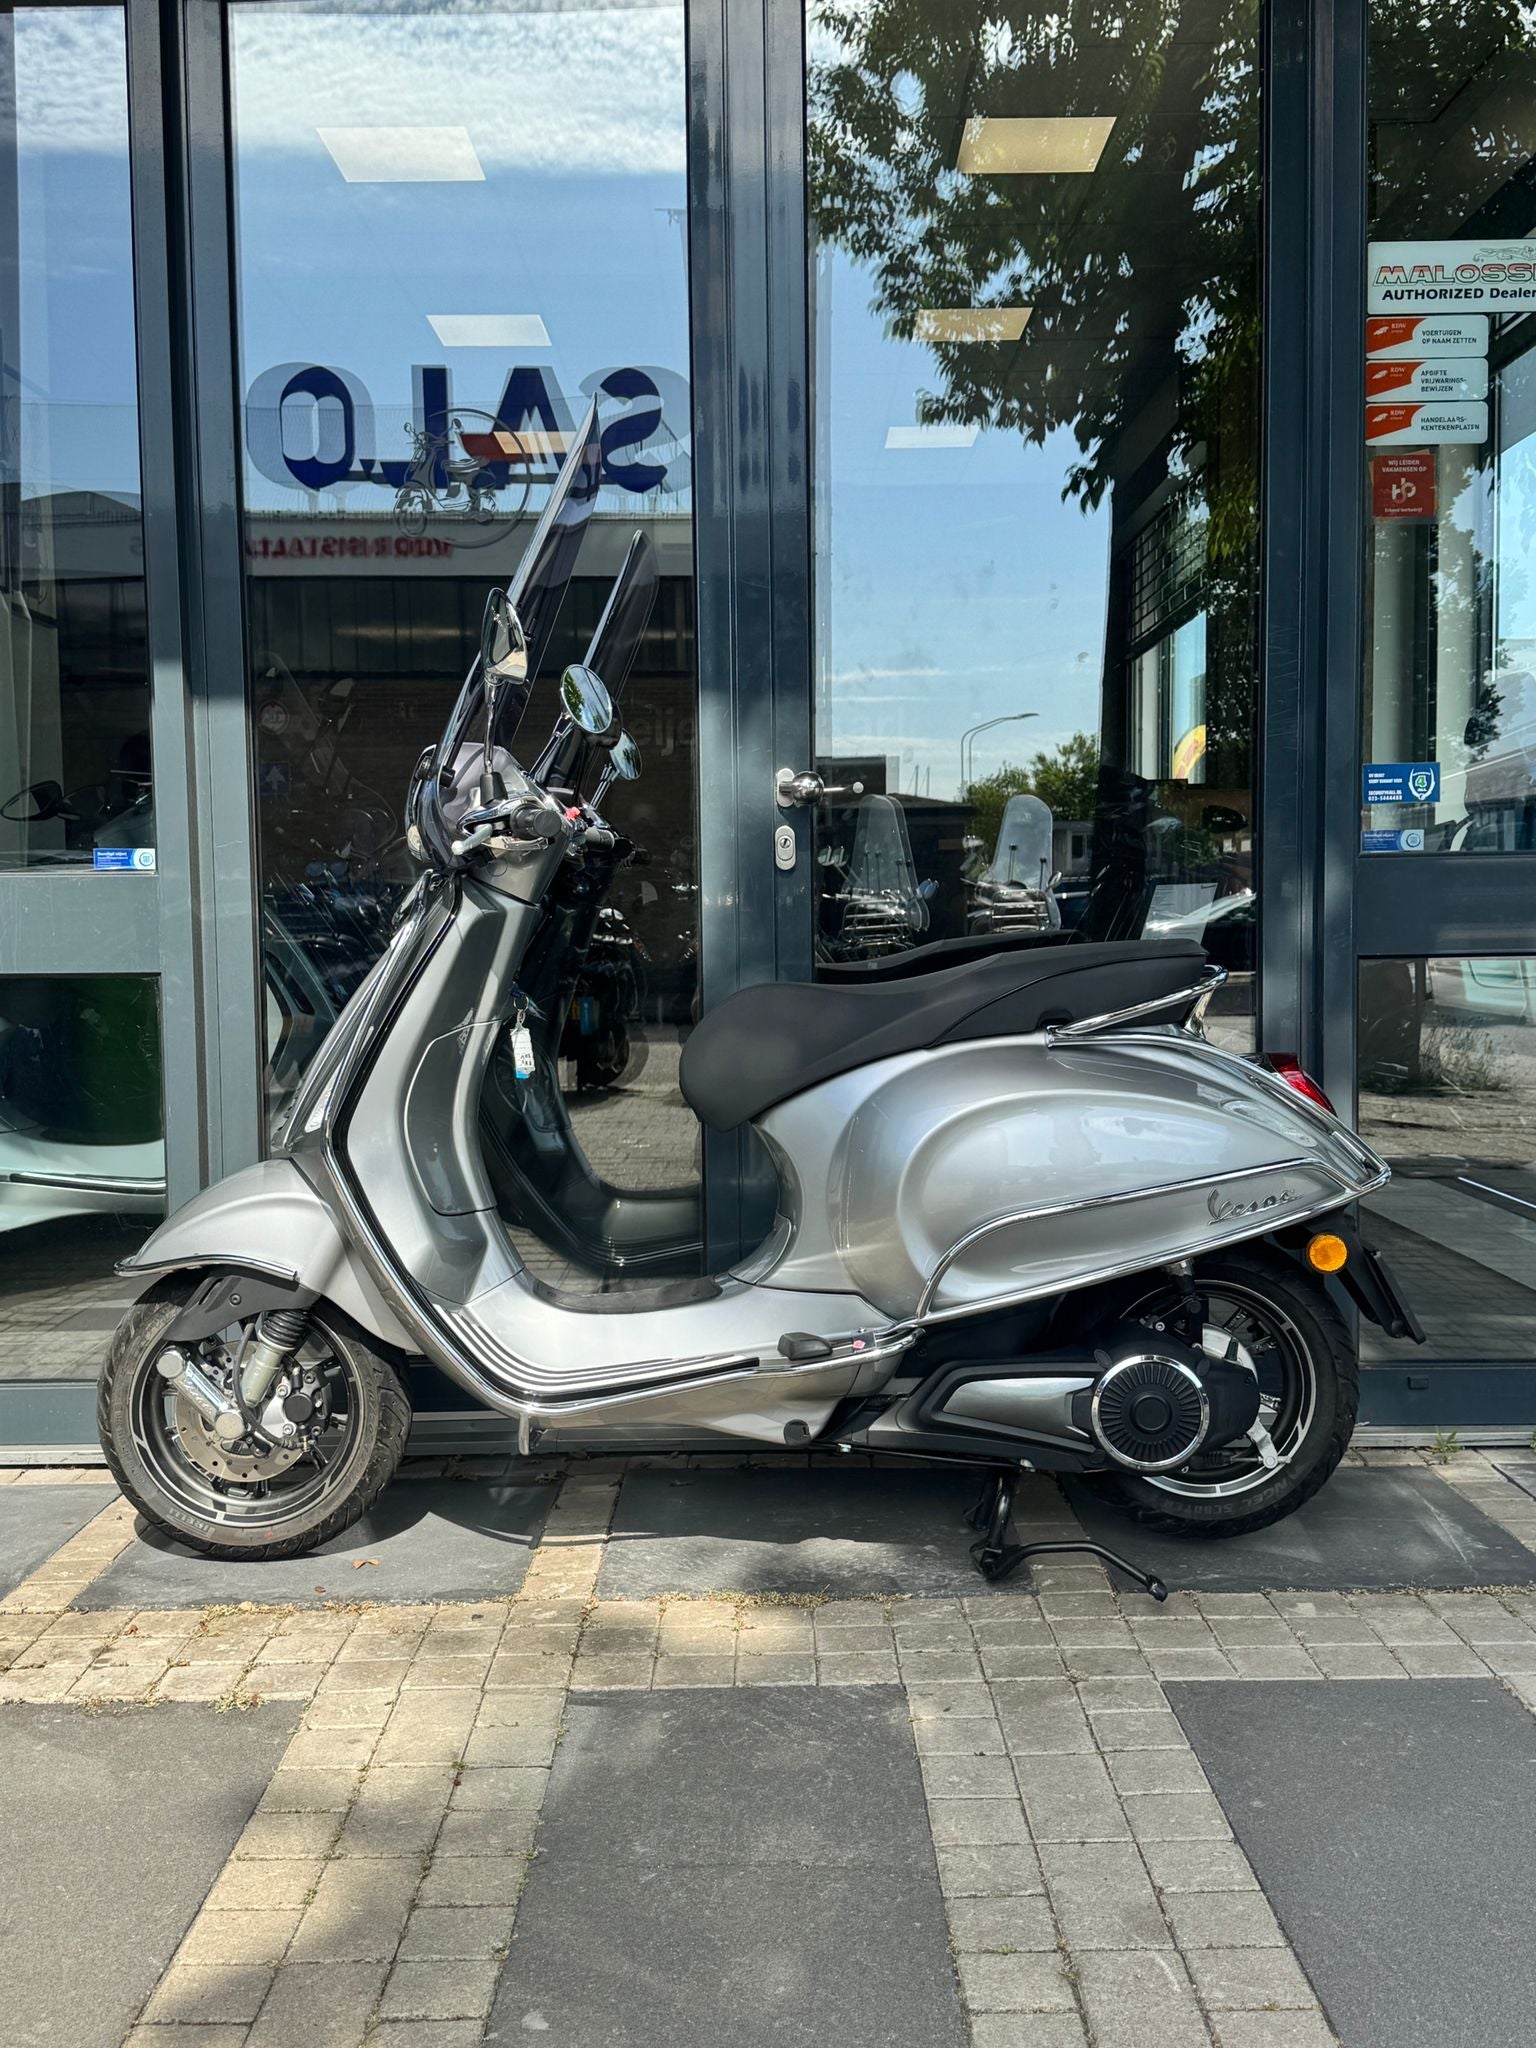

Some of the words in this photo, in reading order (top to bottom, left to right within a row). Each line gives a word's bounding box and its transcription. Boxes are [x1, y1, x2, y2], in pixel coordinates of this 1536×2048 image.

[1382, 288, 1484, 301] AUTHORIZED
[1490, 287, 1536, 299] Dealer
[1421, 329, 1462, 337] VOERTUIGEN
[1432, 337, 1452, 345] NAAM
[1421, 377, 1468, 385] VRIJWARINGS-
